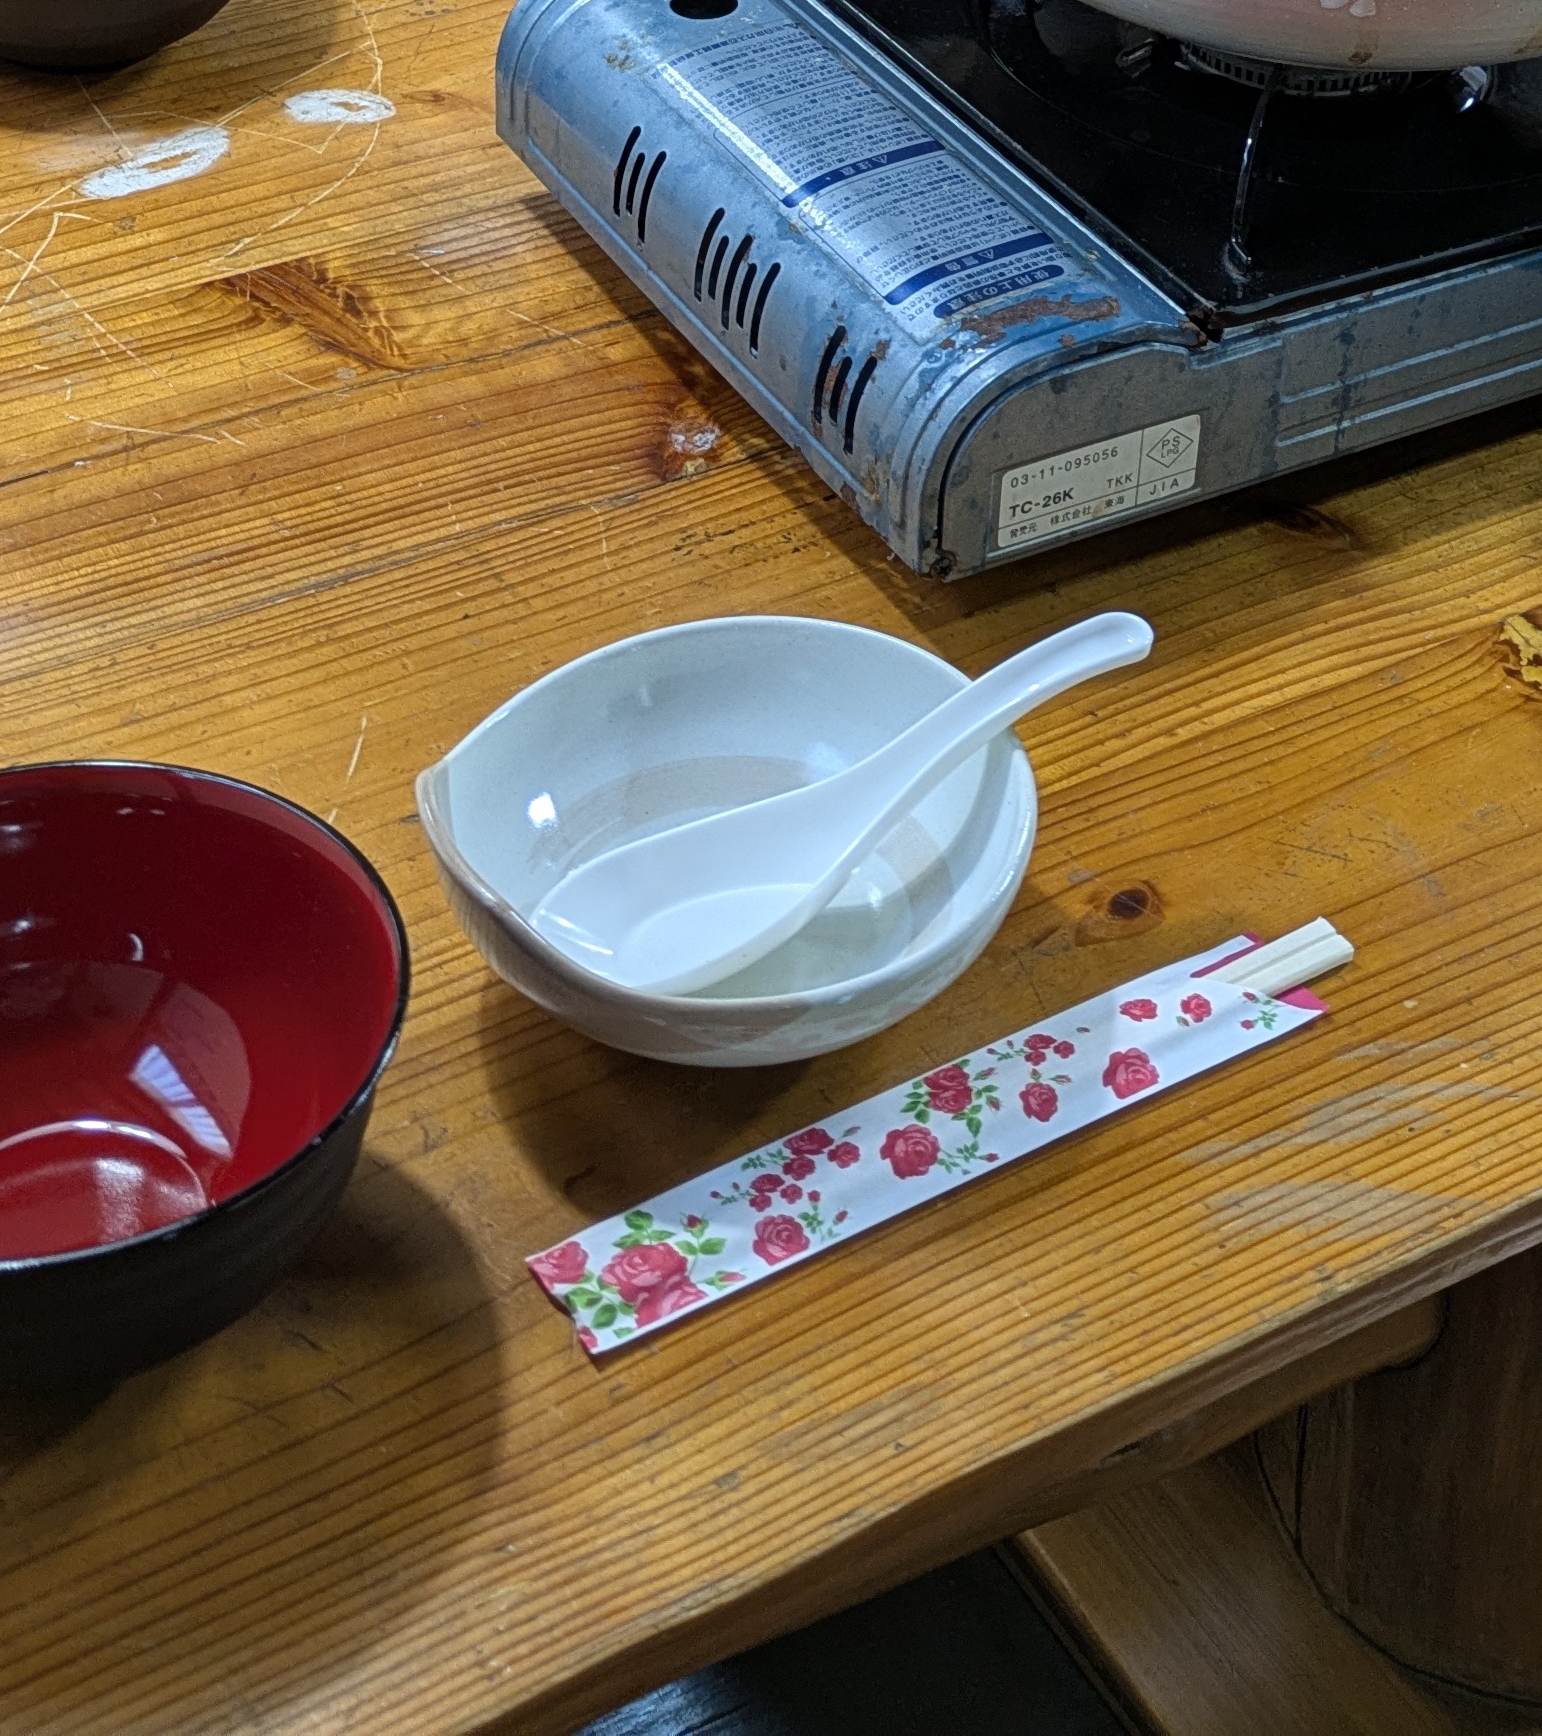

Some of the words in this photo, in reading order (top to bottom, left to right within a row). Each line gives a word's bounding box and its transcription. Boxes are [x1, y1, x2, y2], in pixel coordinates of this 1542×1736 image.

[1161, 435, 1181, 451] PS
[1010, 446, 1119, 489] 03-11-095056
[1106, 472, 1134, 489] TKK
[1009, 487, 1075, 518] TC-26K
[1050, 504, 1093, 526] 株式会社
